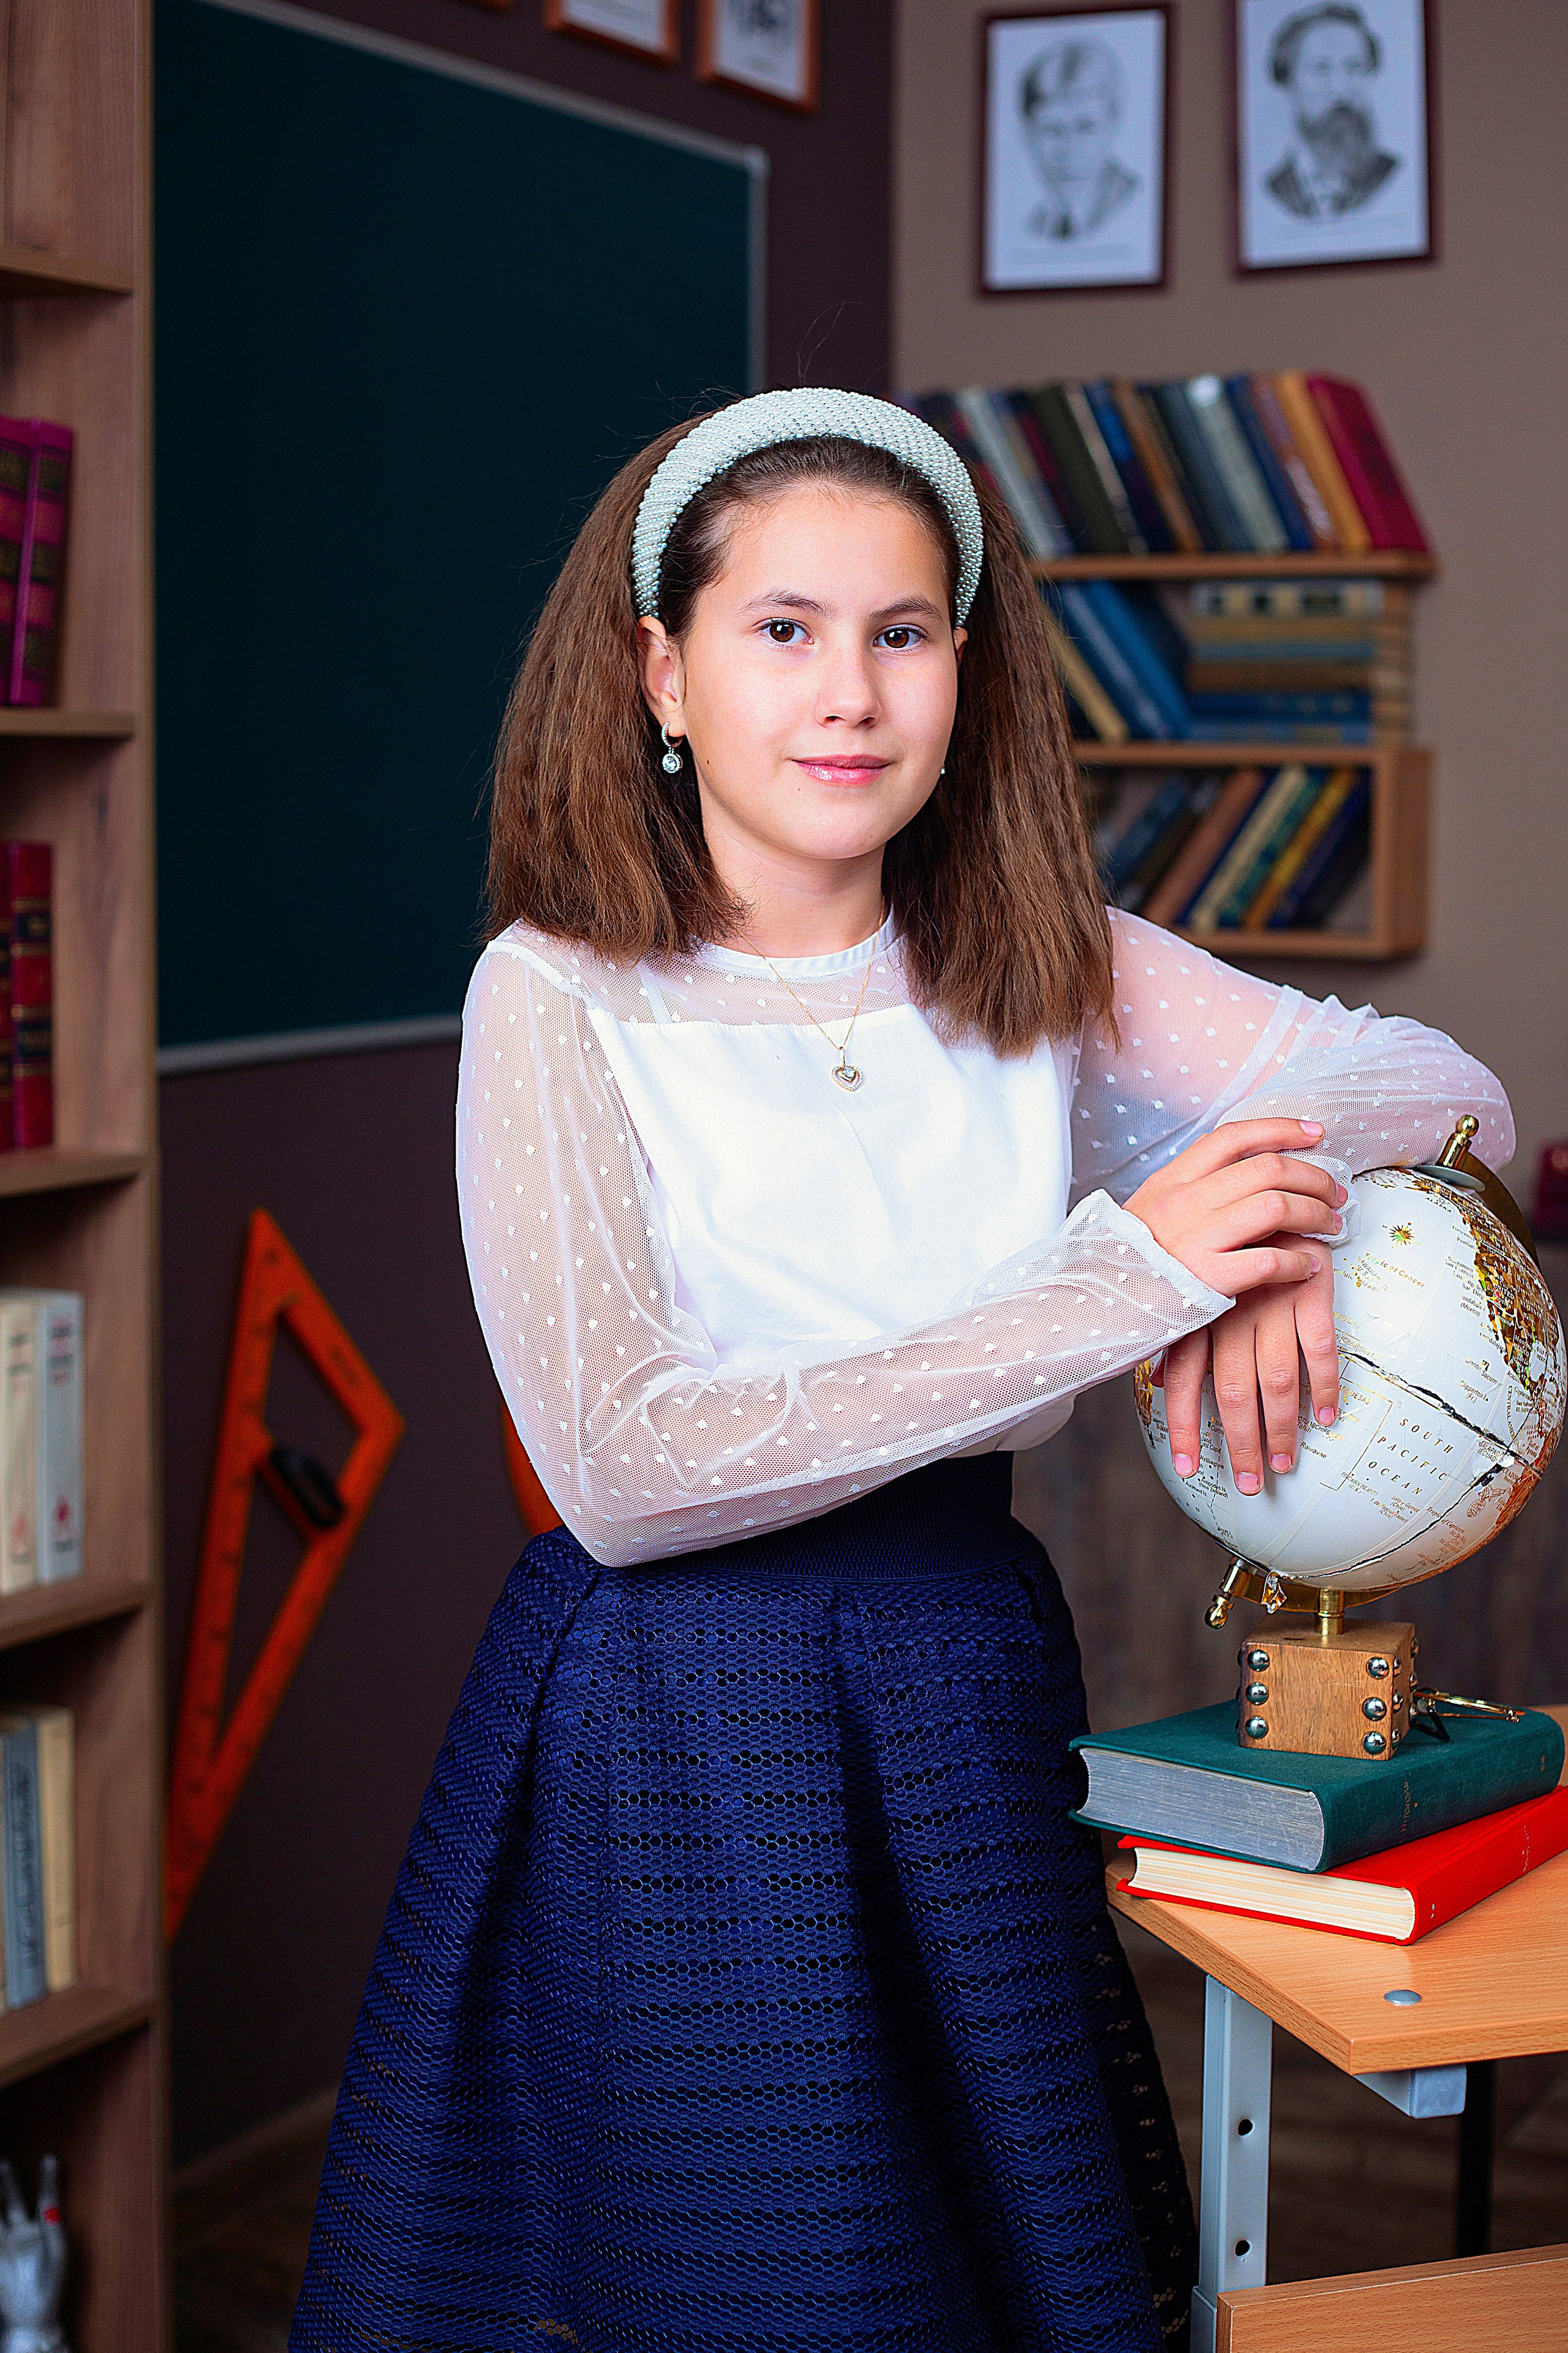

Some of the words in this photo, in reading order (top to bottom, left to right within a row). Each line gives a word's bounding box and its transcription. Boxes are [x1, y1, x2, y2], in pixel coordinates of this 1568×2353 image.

[1360, 1278, 1381, 1293] Hawaii
[1399, 1269, 1425, 1288] Cancer
[1460, 1301, 1481, 1317] (Mexico)
[1339, 1384, 1371, 1405] ARQUESAS
[1459, 1380, 1484, 1399] Clipperton
[1400, 1418, 1453, 1454] SOUTH
[1300, 1441, 1327, 1459] Raivavae
[1377, 1436, 1447, 1481] PACIFIC
[1368, 1461, 1423, 1495] OCEAN
[1378, 1508, 1393, 1519] (Chile)
[1390, 1501, 1406, 1511] (Chile)
